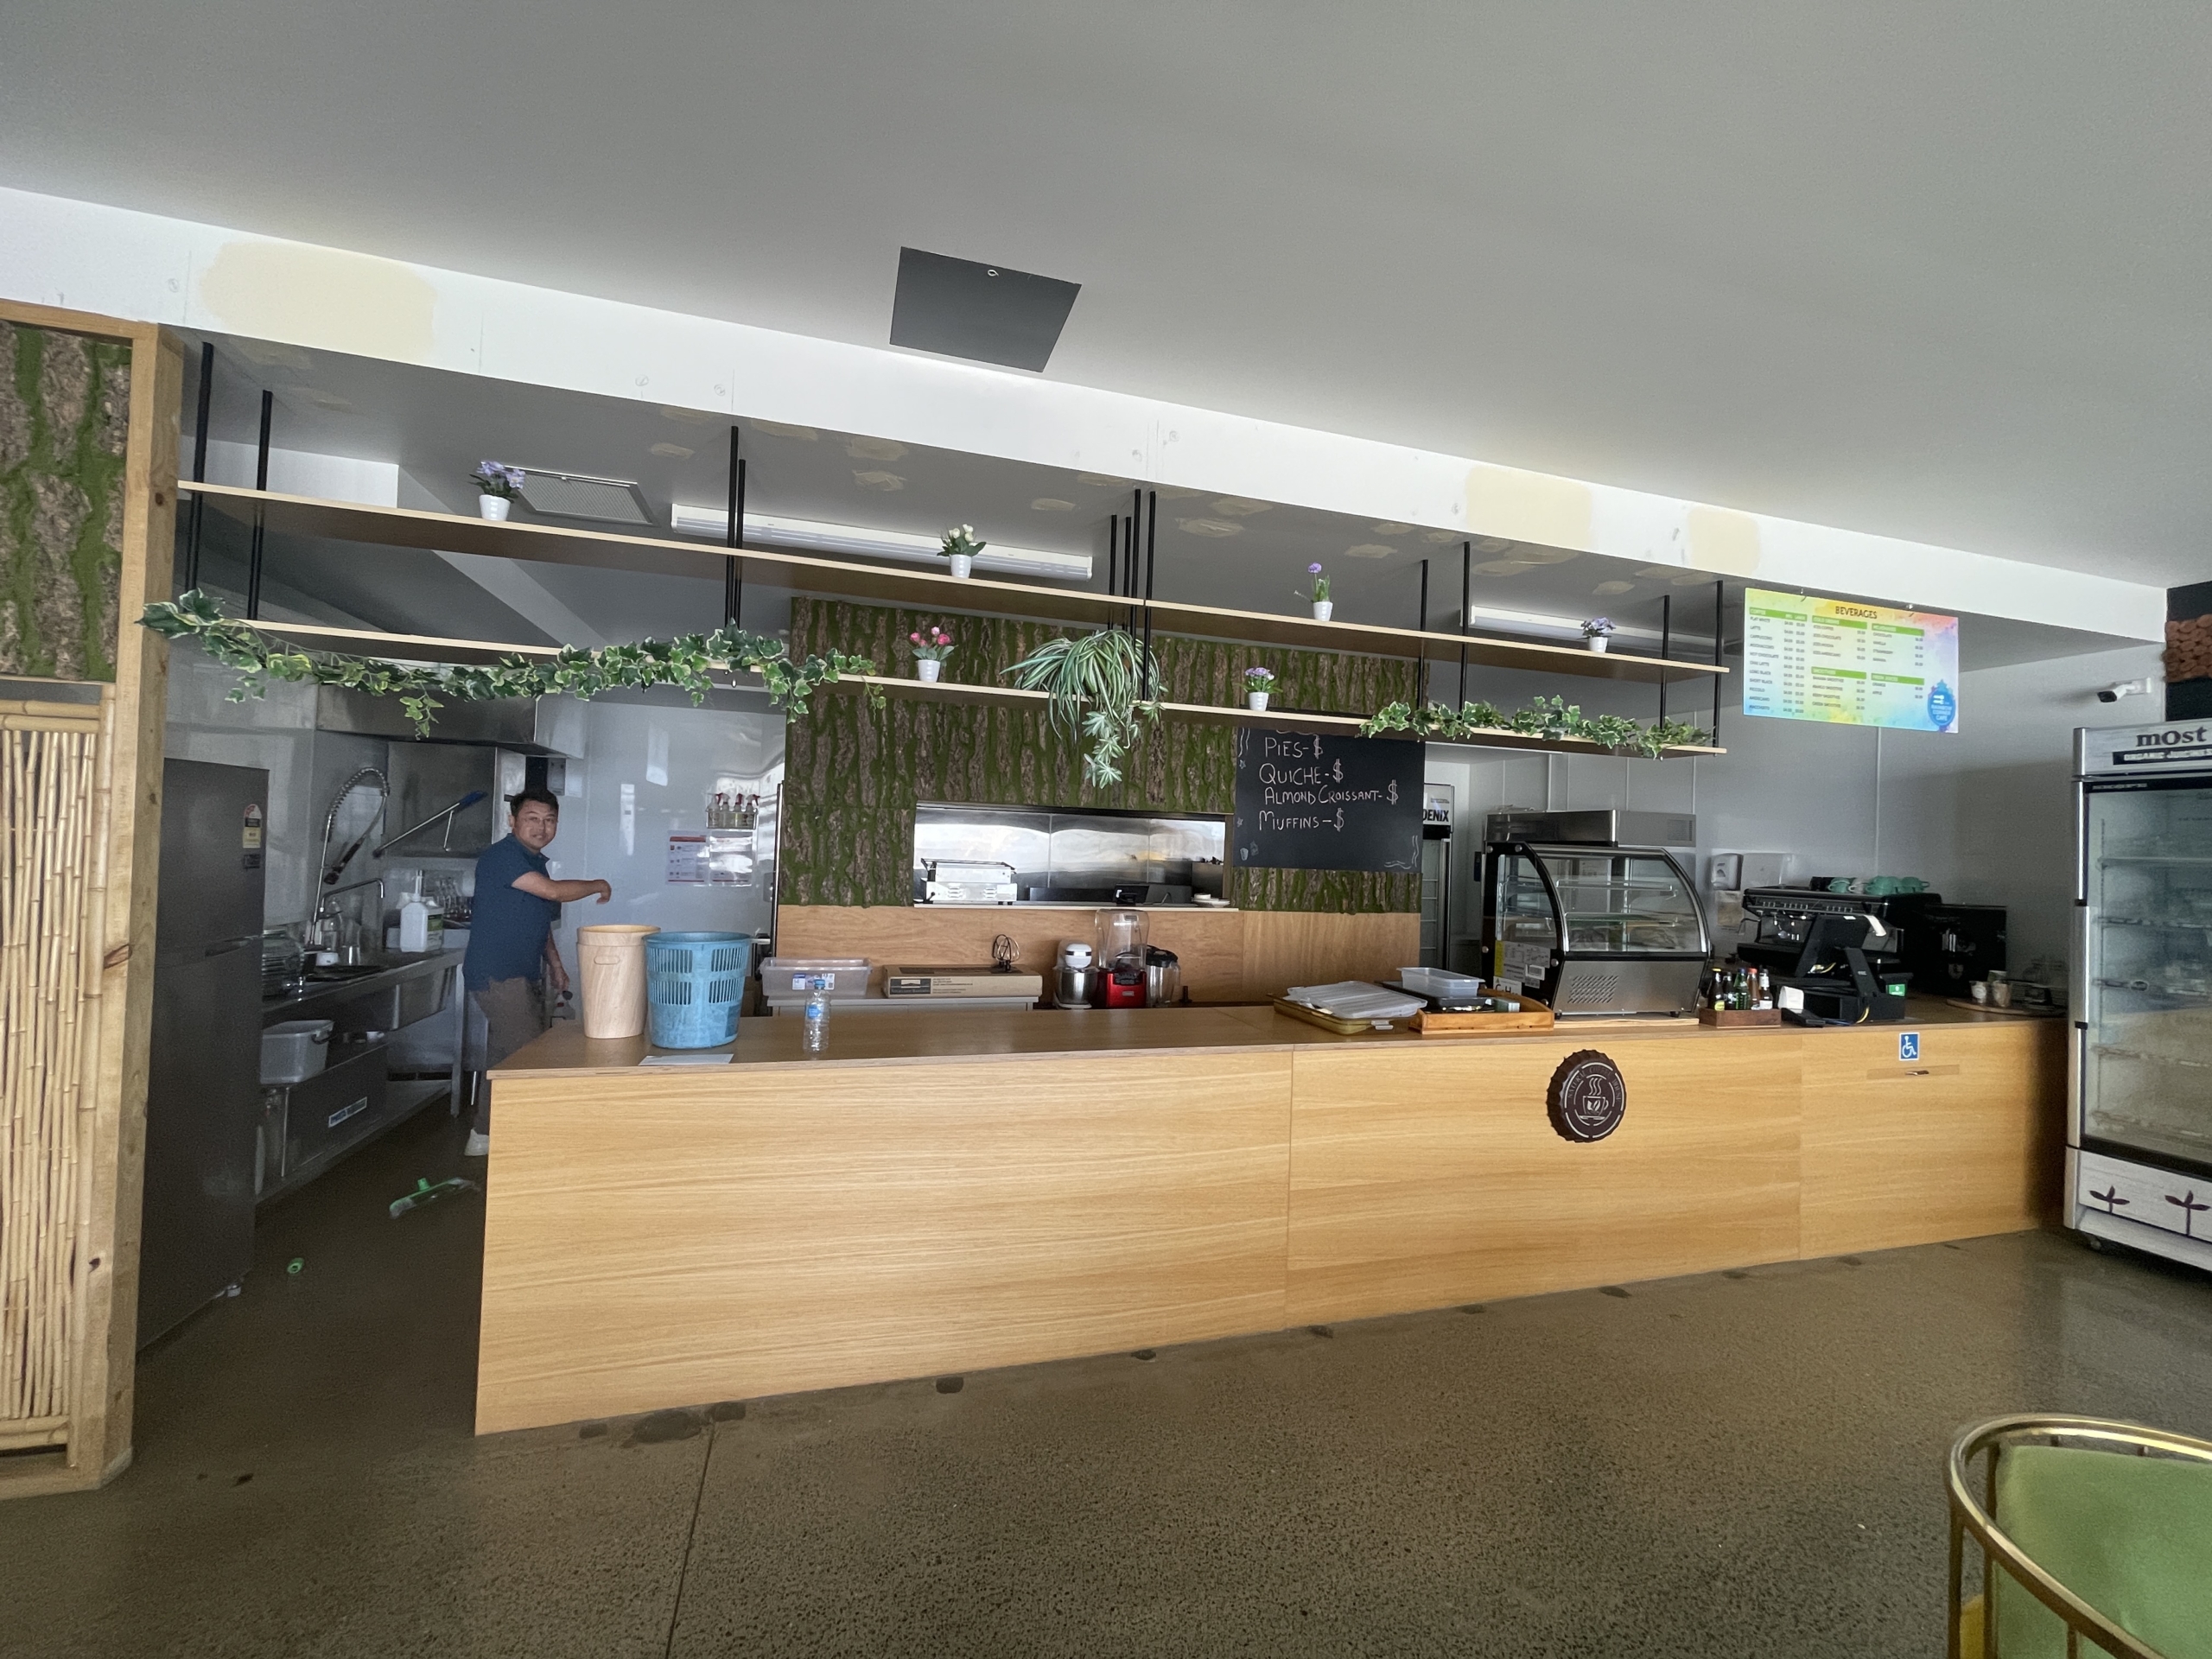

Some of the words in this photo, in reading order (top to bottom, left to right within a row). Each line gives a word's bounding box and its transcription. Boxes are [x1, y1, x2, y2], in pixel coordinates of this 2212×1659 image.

[1835, 606, 1877, 619] BEVERAGES
[1265, 787, 1316, 805] ALMOND
[1259, 810, 1319, 831] MUFFINS
[1423, 809, 1449, 822] OENIX
